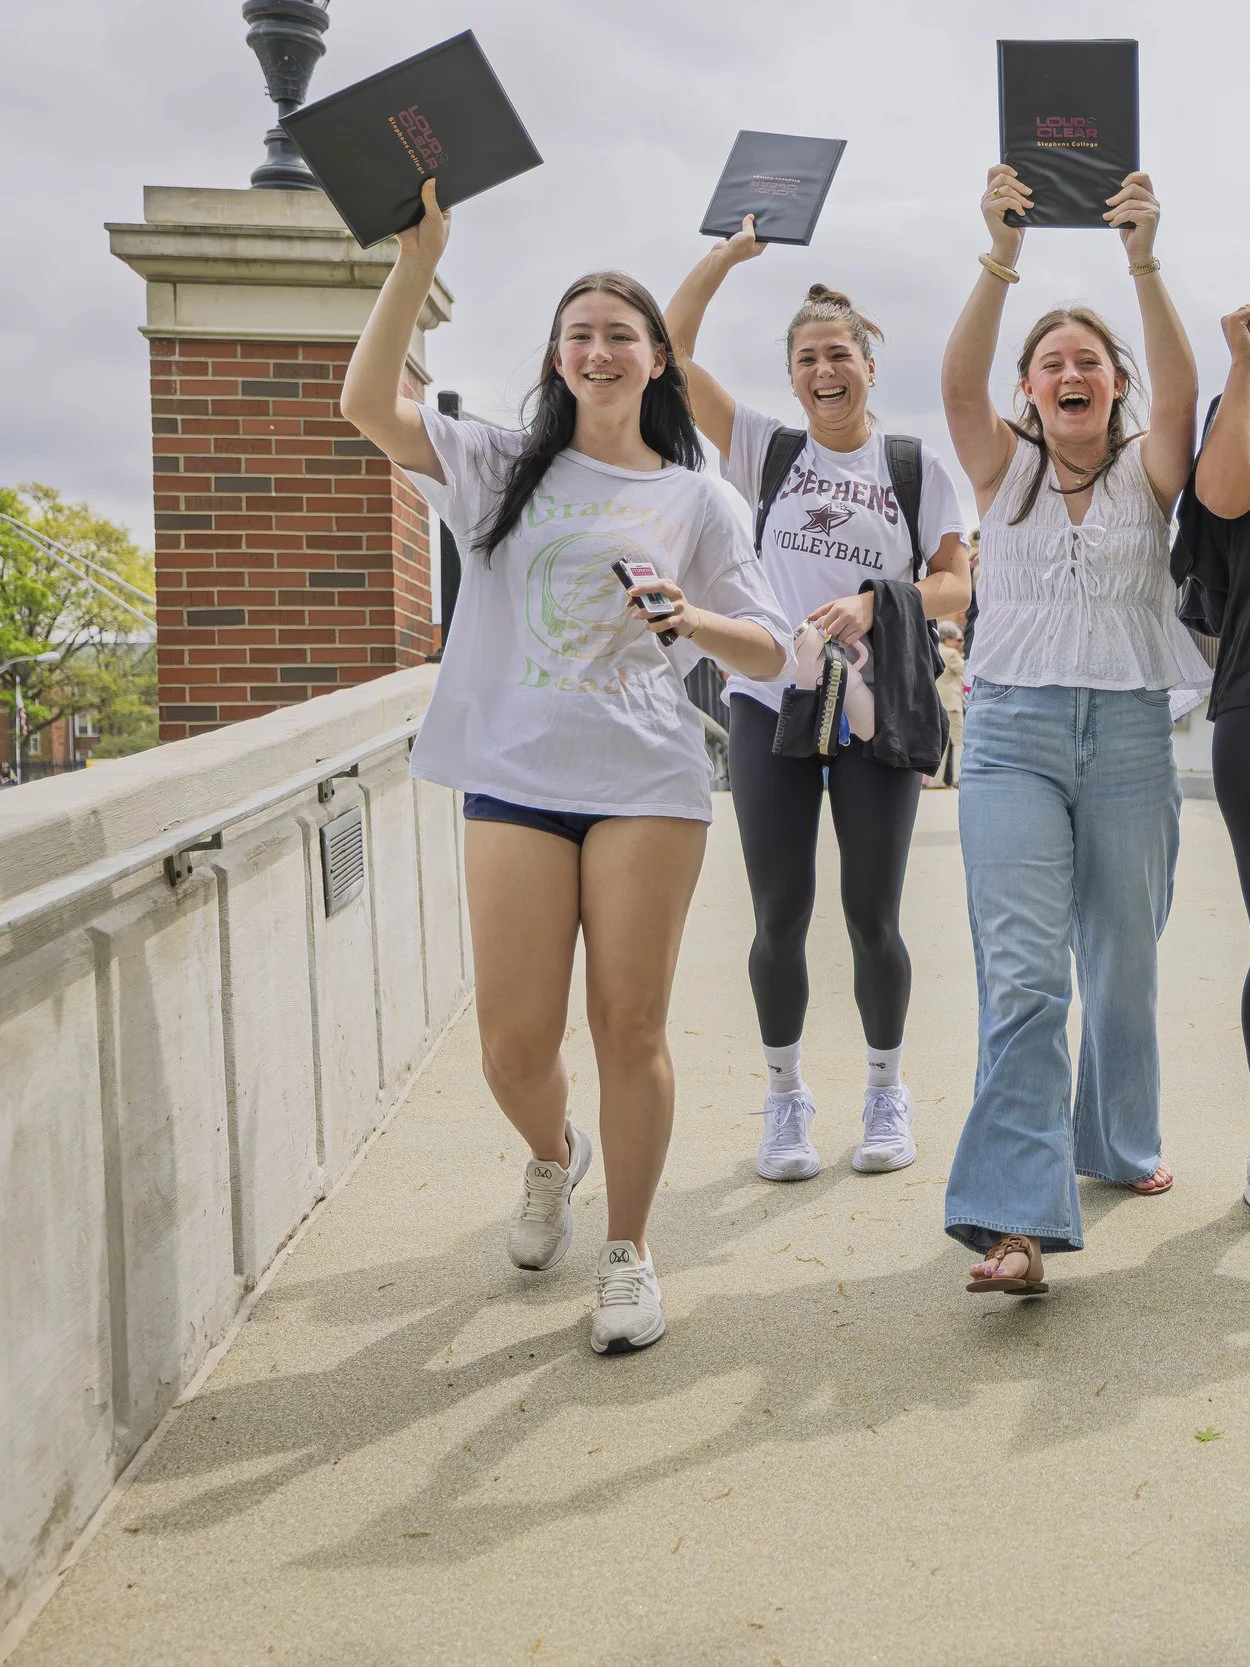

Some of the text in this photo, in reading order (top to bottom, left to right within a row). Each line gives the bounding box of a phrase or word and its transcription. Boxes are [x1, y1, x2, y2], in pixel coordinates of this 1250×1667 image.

[388, 116, 425, 175] Stephens College
[398, 110, 439, 169] CLEAR
[1036, 116, 1086, 127] LOUD
[1036, 127, 1098, 138] CLEAR
[773, 529, 884, 571] VOLLEYBALL
[817, 661, 844, 747] lululemon
